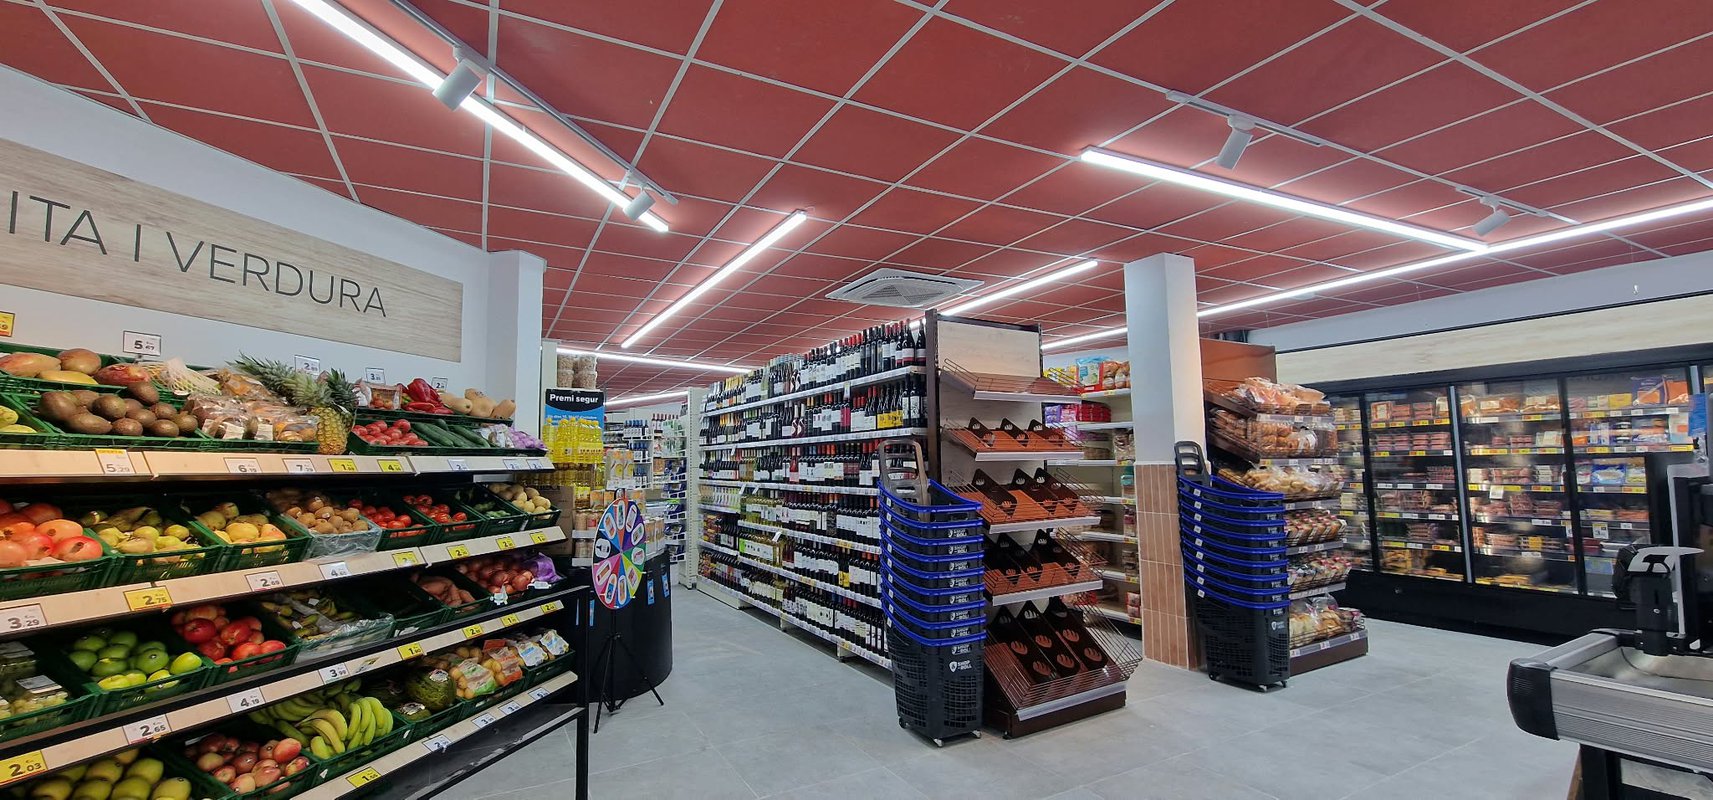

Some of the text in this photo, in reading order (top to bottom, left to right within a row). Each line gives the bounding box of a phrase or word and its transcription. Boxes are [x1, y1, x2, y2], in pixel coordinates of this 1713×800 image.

[8, 190, 387, 318] ITA I VERDURA
[549, 393, 599, 404] Premi segur
[8, 616, 40, 629] 3.29
[139, 723, 166, 737] 2.65
[8, 762, 42, 777] 2.03
